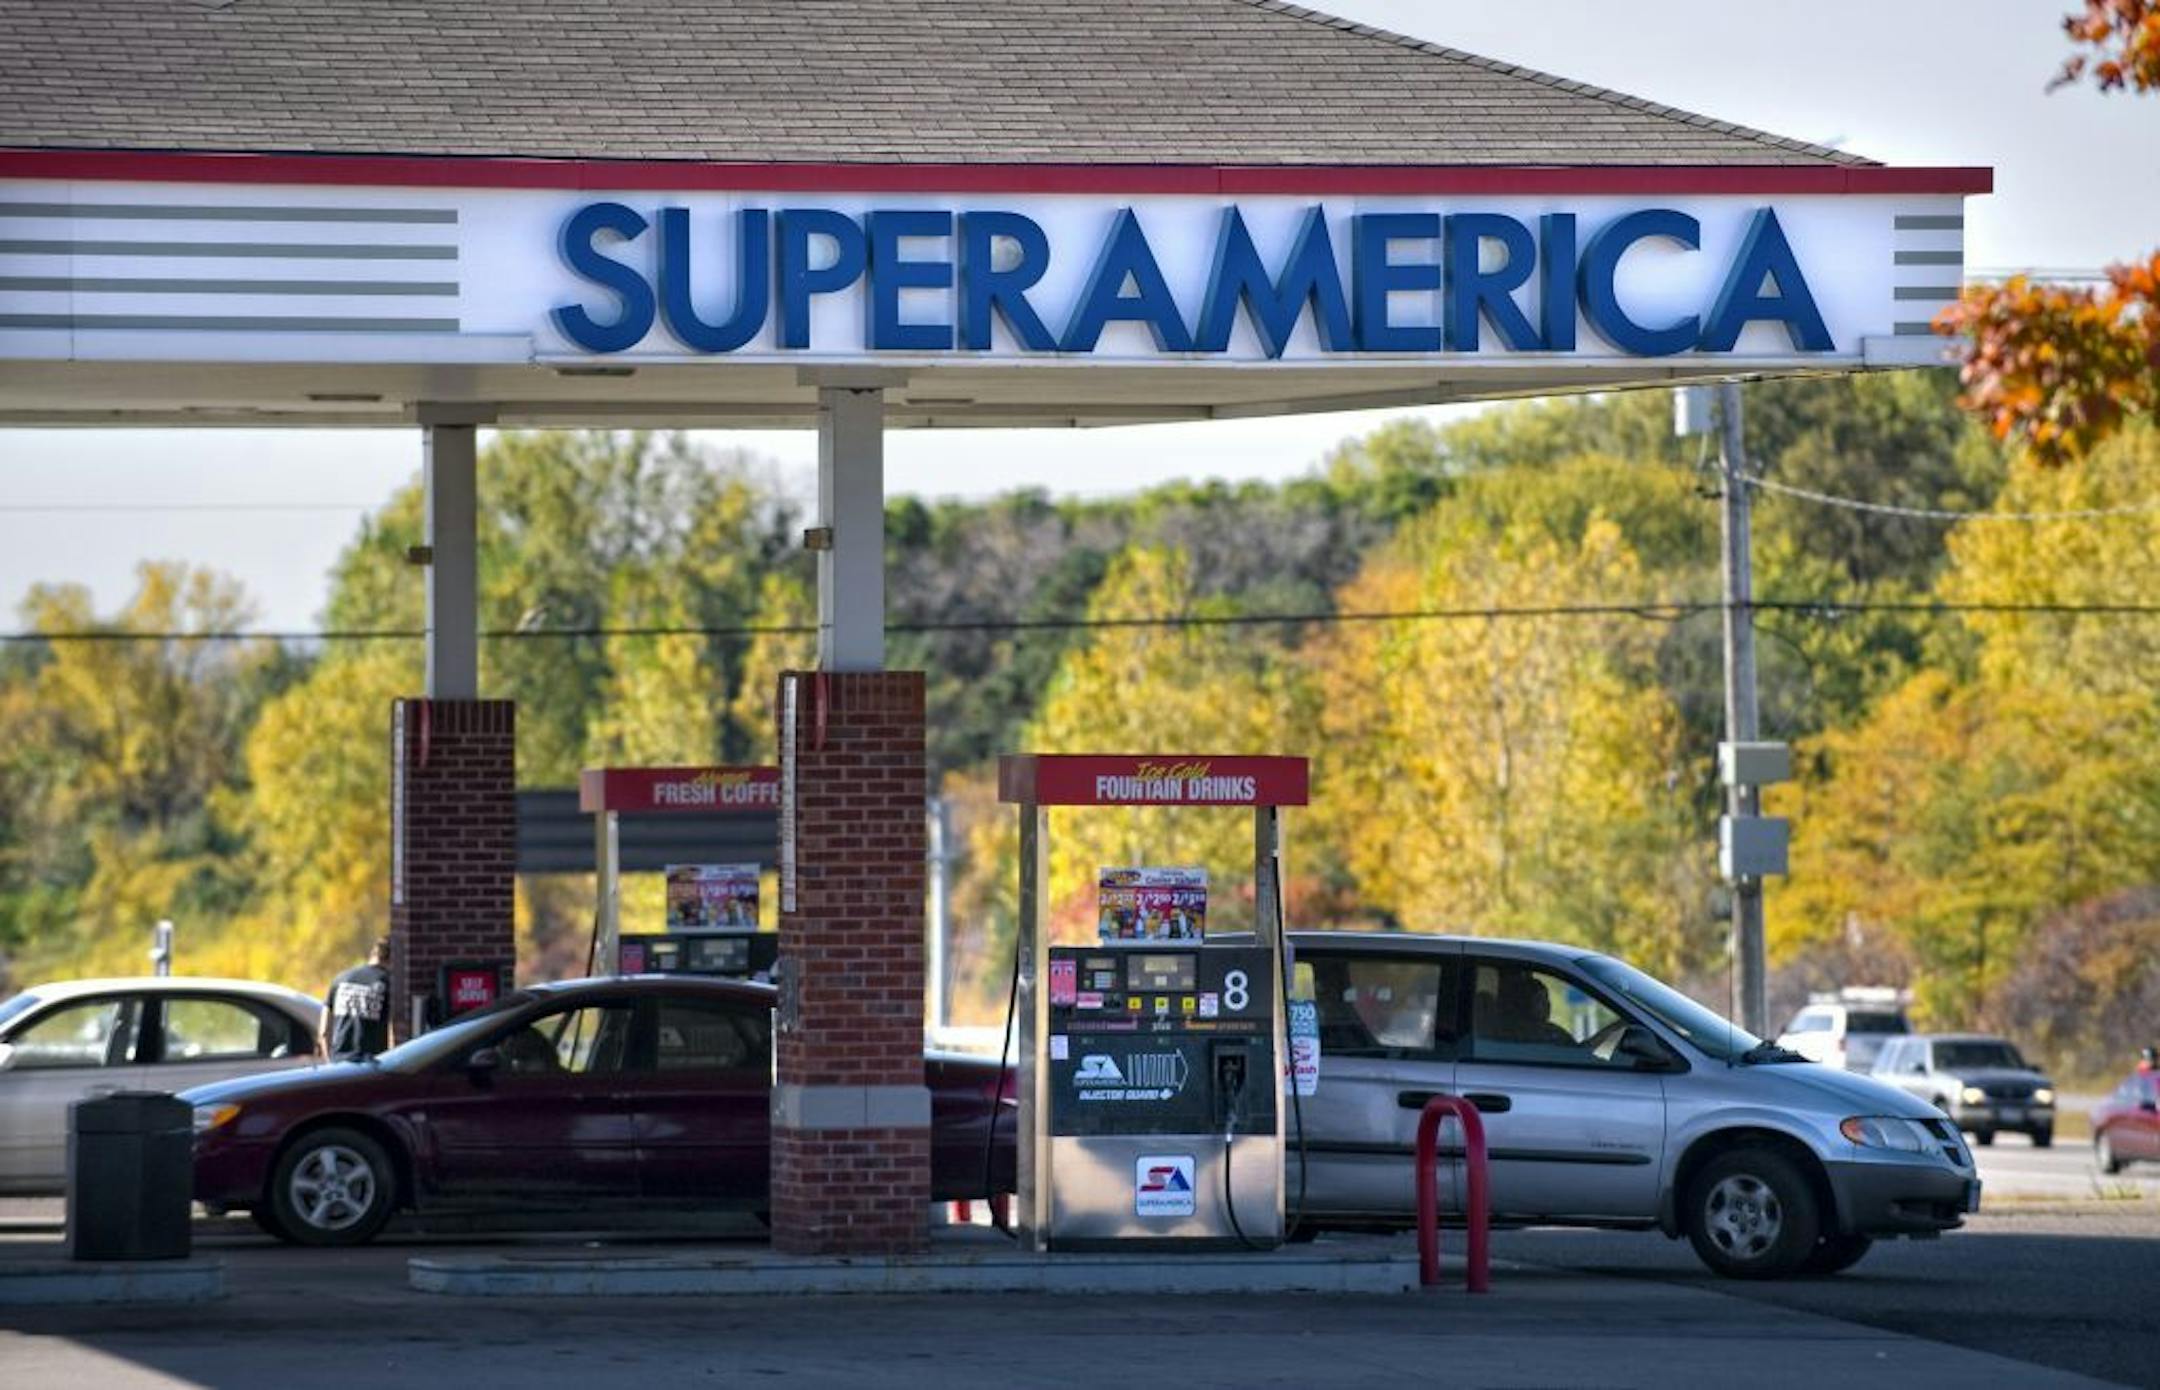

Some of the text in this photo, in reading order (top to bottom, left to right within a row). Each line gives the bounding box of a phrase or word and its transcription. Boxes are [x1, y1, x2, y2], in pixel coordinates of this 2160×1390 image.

[550, 202, 1836, 358] SUPERAMERICA
[1135, 761, 1212, 781] Ice Cold
[653, 782, 715, 804] FRESH
[1095, 775, 1257, 800] FOUNTAIN DRINKS
[457, 989, 488, 1003] SERVE
[1224, 969, 1250, 1011] 8
[1074, 1054, 1124, 1079] SA
[1139, 1166, 1191, 1192] SA
